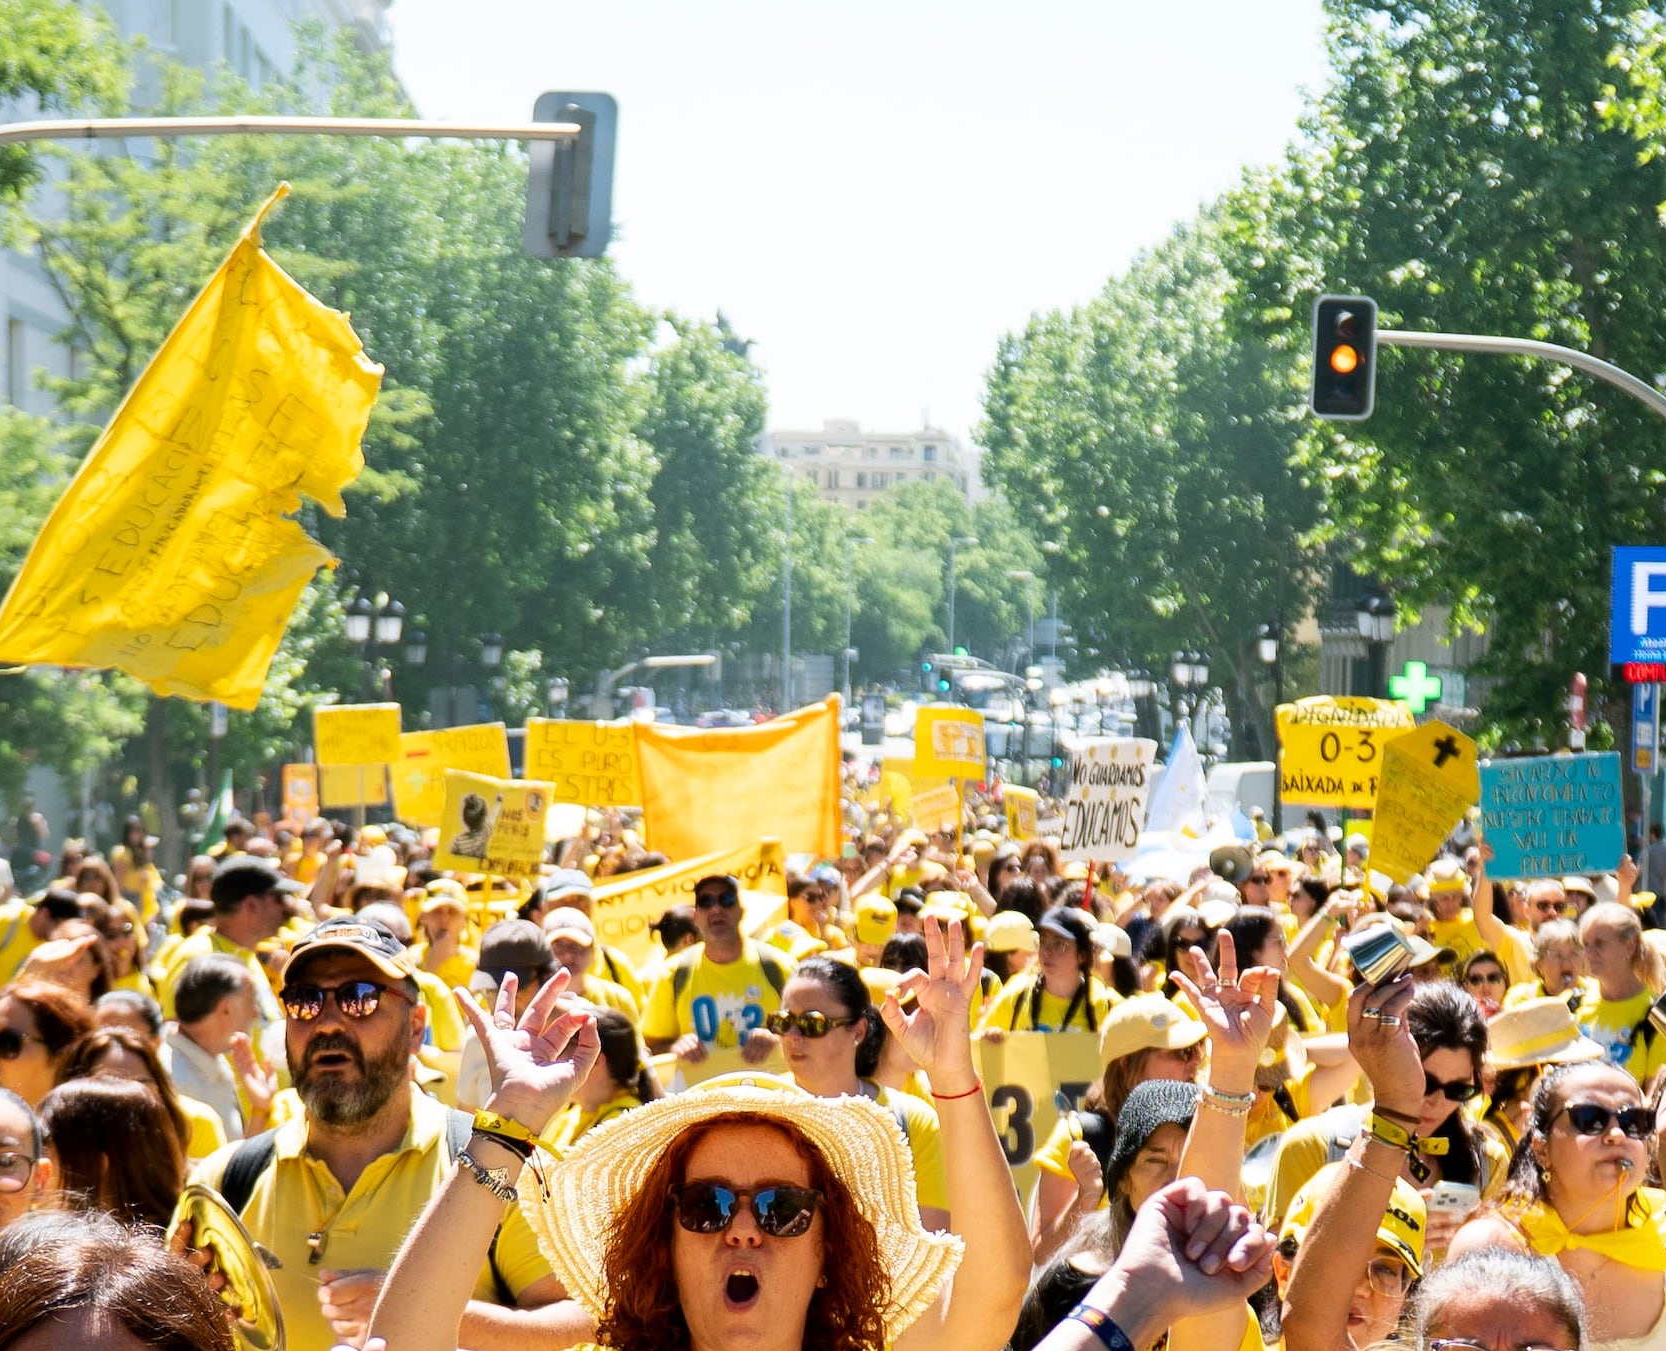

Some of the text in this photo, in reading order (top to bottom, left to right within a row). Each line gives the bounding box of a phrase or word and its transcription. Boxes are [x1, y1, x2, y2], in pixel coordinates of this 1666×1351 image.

[537, 750, 632, 774] ES PURO
[1321, 730, 1376, 763] 0-3
[1073, 756, 1147, 788] NO GUARDAMOS
[1061, 796, 1142, 851] EDUCAMOS
